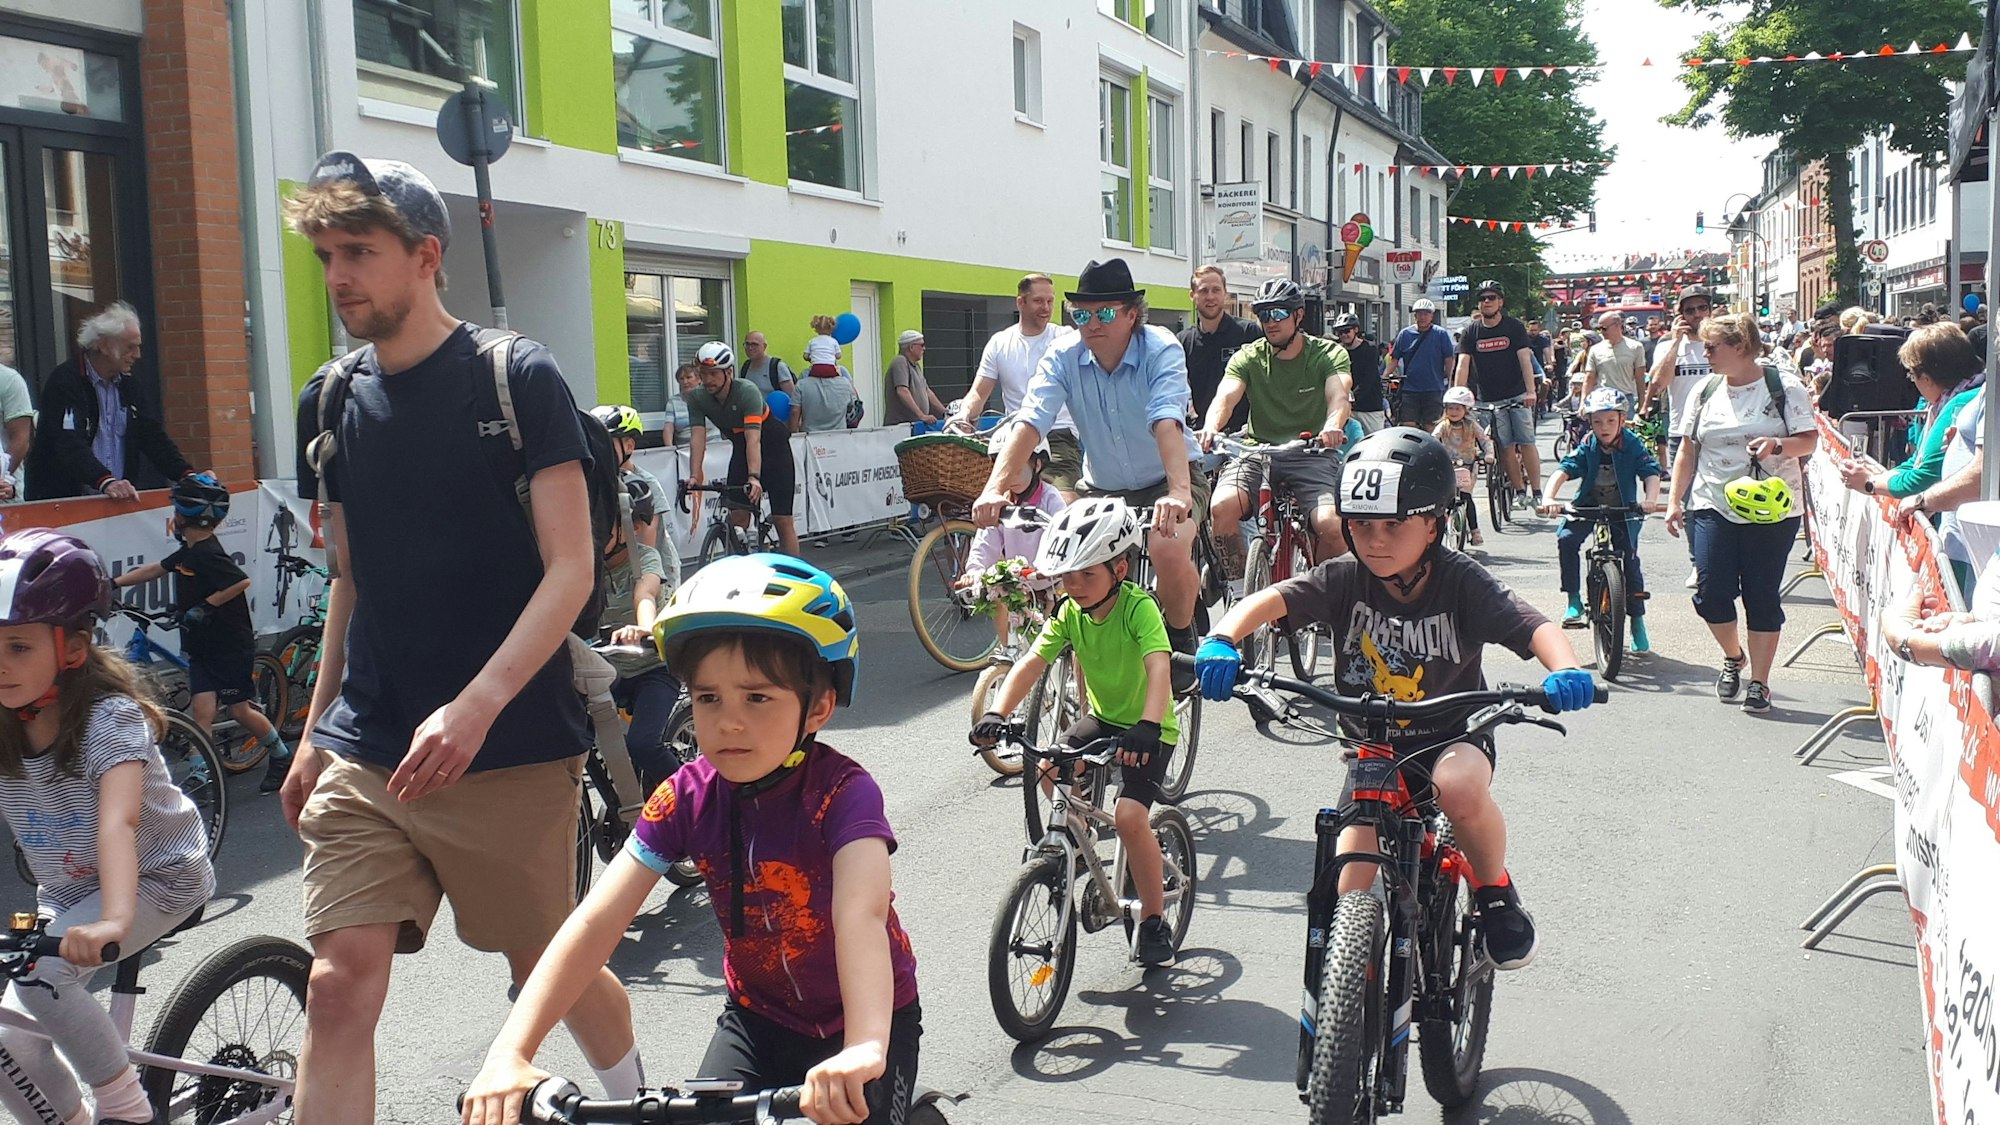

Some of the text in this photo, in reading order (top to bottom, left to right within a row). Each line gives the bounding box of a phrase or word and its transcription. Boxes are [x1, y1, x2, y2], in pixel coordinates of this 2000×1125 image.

[1218, 189, 1256, 198] BÄCKEREI
[595, 219, 616, 250] 73
[1396, 263, 1411, 272] früh
[835, 470, 860, 487] LAUFEN
[861, 468, 872, 483] IST
[1351, 468, 1382, 501] 29
[1047, 536, 1070, 562] 44
[0, 1046, 65, 1125] PECIALIZE
